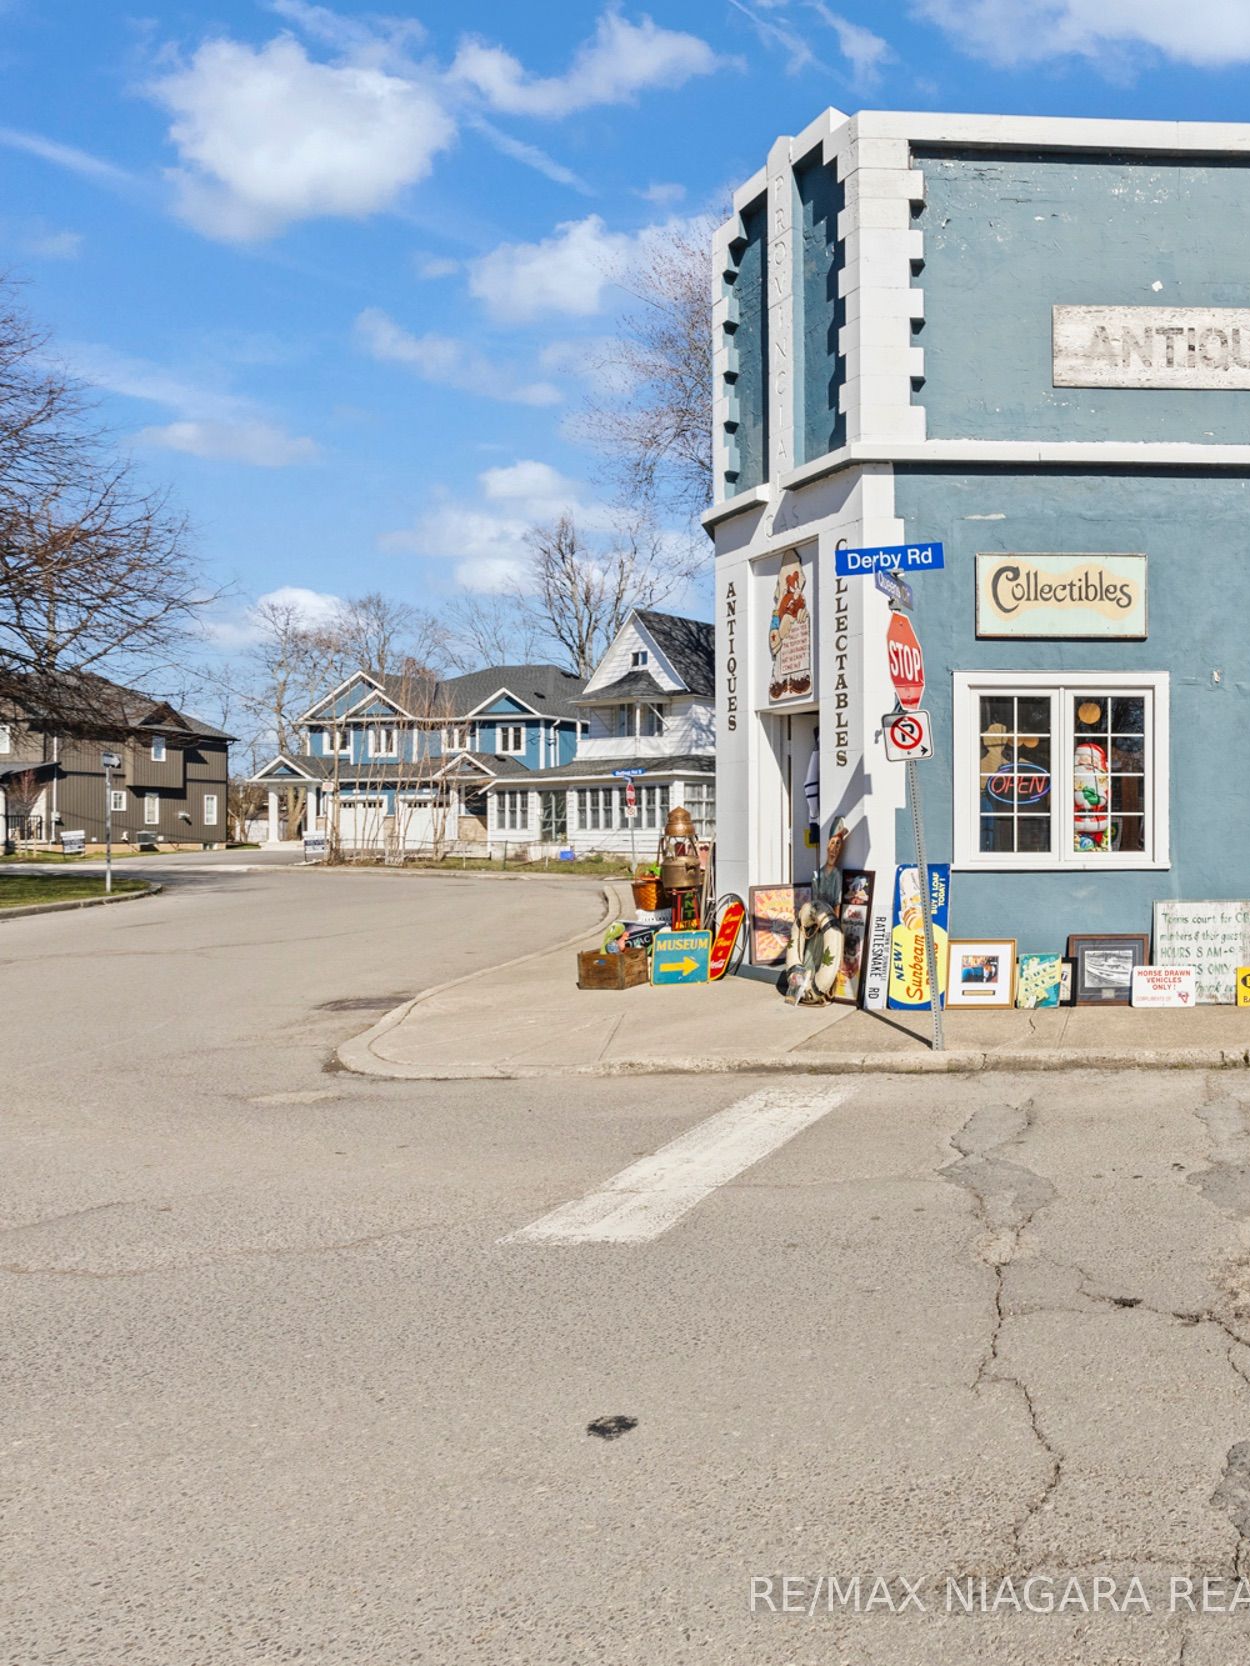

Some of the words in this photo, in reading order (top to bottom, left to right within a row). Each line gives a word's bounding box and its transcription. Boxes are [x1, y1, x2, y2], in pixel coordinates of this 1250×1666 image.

[847, 550, 902, 570] Derby
[907, 547, 933, 566] Rd
[991, 565, 1132, 614] Collectibles
[726, 581, 738, 732] ANTIQUES
[834, 538, 849, 768] CLLECTABLES
[888, 639, 922, 682] STOP
[990, 775, 1047, 794] OPEN
[1192, 912, 1216, 924] court
[1220, 911, 1232, 924] for
[656, 938, 709, 952] MUSEUM
[869, 916, 887, 978] RATTLESNAKE
[893, 942, 906, 982] NEW!
[1160, 946, 1191, 958] HOURS
[906, 934, 926, 1001] Sunbeam
[868, 987, 880, 1000] RD
